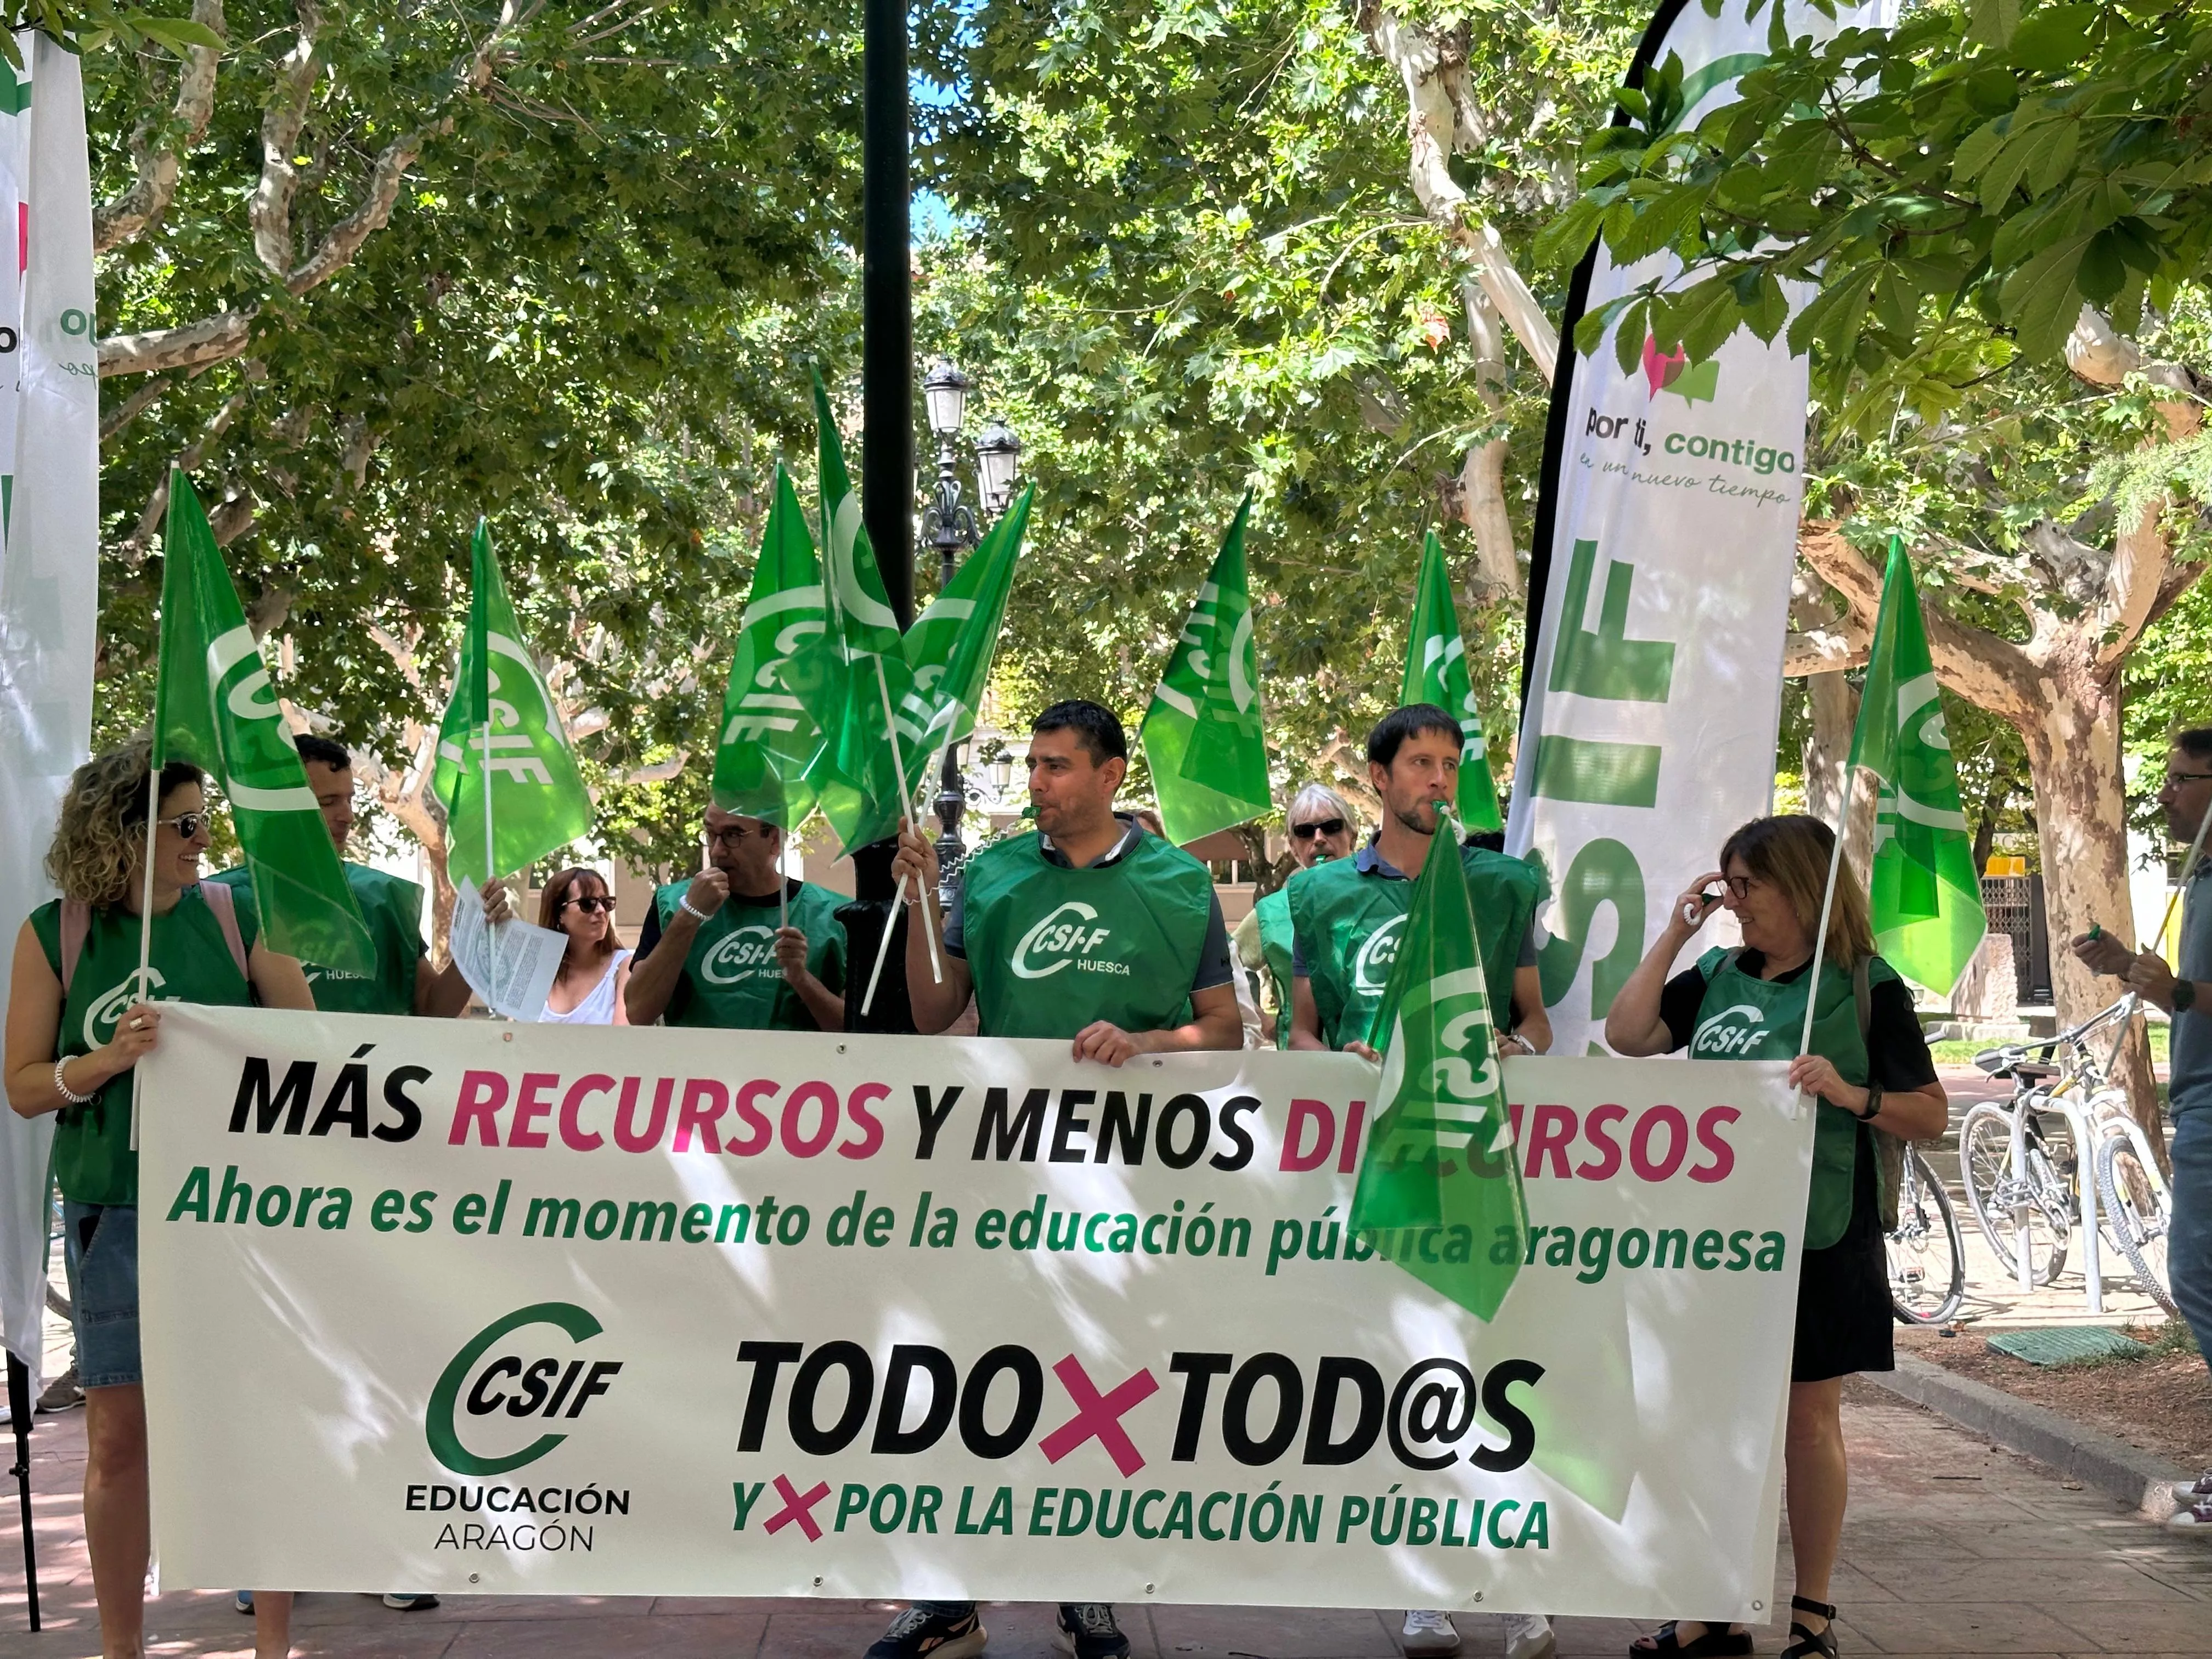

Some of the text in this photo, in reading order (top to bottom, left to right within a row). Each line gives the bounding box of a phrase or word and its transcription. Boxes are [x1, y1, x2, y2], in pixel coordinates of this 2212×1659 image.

[1585, 407, 1795, 475] por ti, contigo
[1602, 460, 1629, 477] un
[1631, 471, 1701, 488] nuevo
[1708, 473, 1791, 509] tiempo
[1531, 539, 1675, 1057] SIF
[1077, 958, 1130, 976] HUESCA
[227, 1042, 433, 1143] MÁS
[447, 1069, 893, 1161] RECURSOS
[911, 1085, 965, 1161] Y
[970, 1086, 1262, 1173] MENOS
[166, 1165, 353, 1232] Ahora
[370, 1188, 438, 1233] es
[452, 1178, 513, 1235] el
[522, 1190, 811, 1247] momento
[826, 1189, 895, 1248] de
[908, 1190, 958, 1249] la
[974, 1193, 1252, 1259] educación
[1488, 1223, 1787, 1285] aragonesa
[466, 1355, 624, 1419] CSIF
[404, 1482, 631, 1515] EDUCACIÓN
[732, 1482, 766, 1531] Y
[834, 1482, 943, 1534] POR
[954, 1486, 1013, 1535] LA
[1028, 1480, 1324, 1543] EDUCACIÓN
[1336, 1483, 1549, 1550] PÚBLICA
[433, 1519, 594, 1552] ARAGÓN
